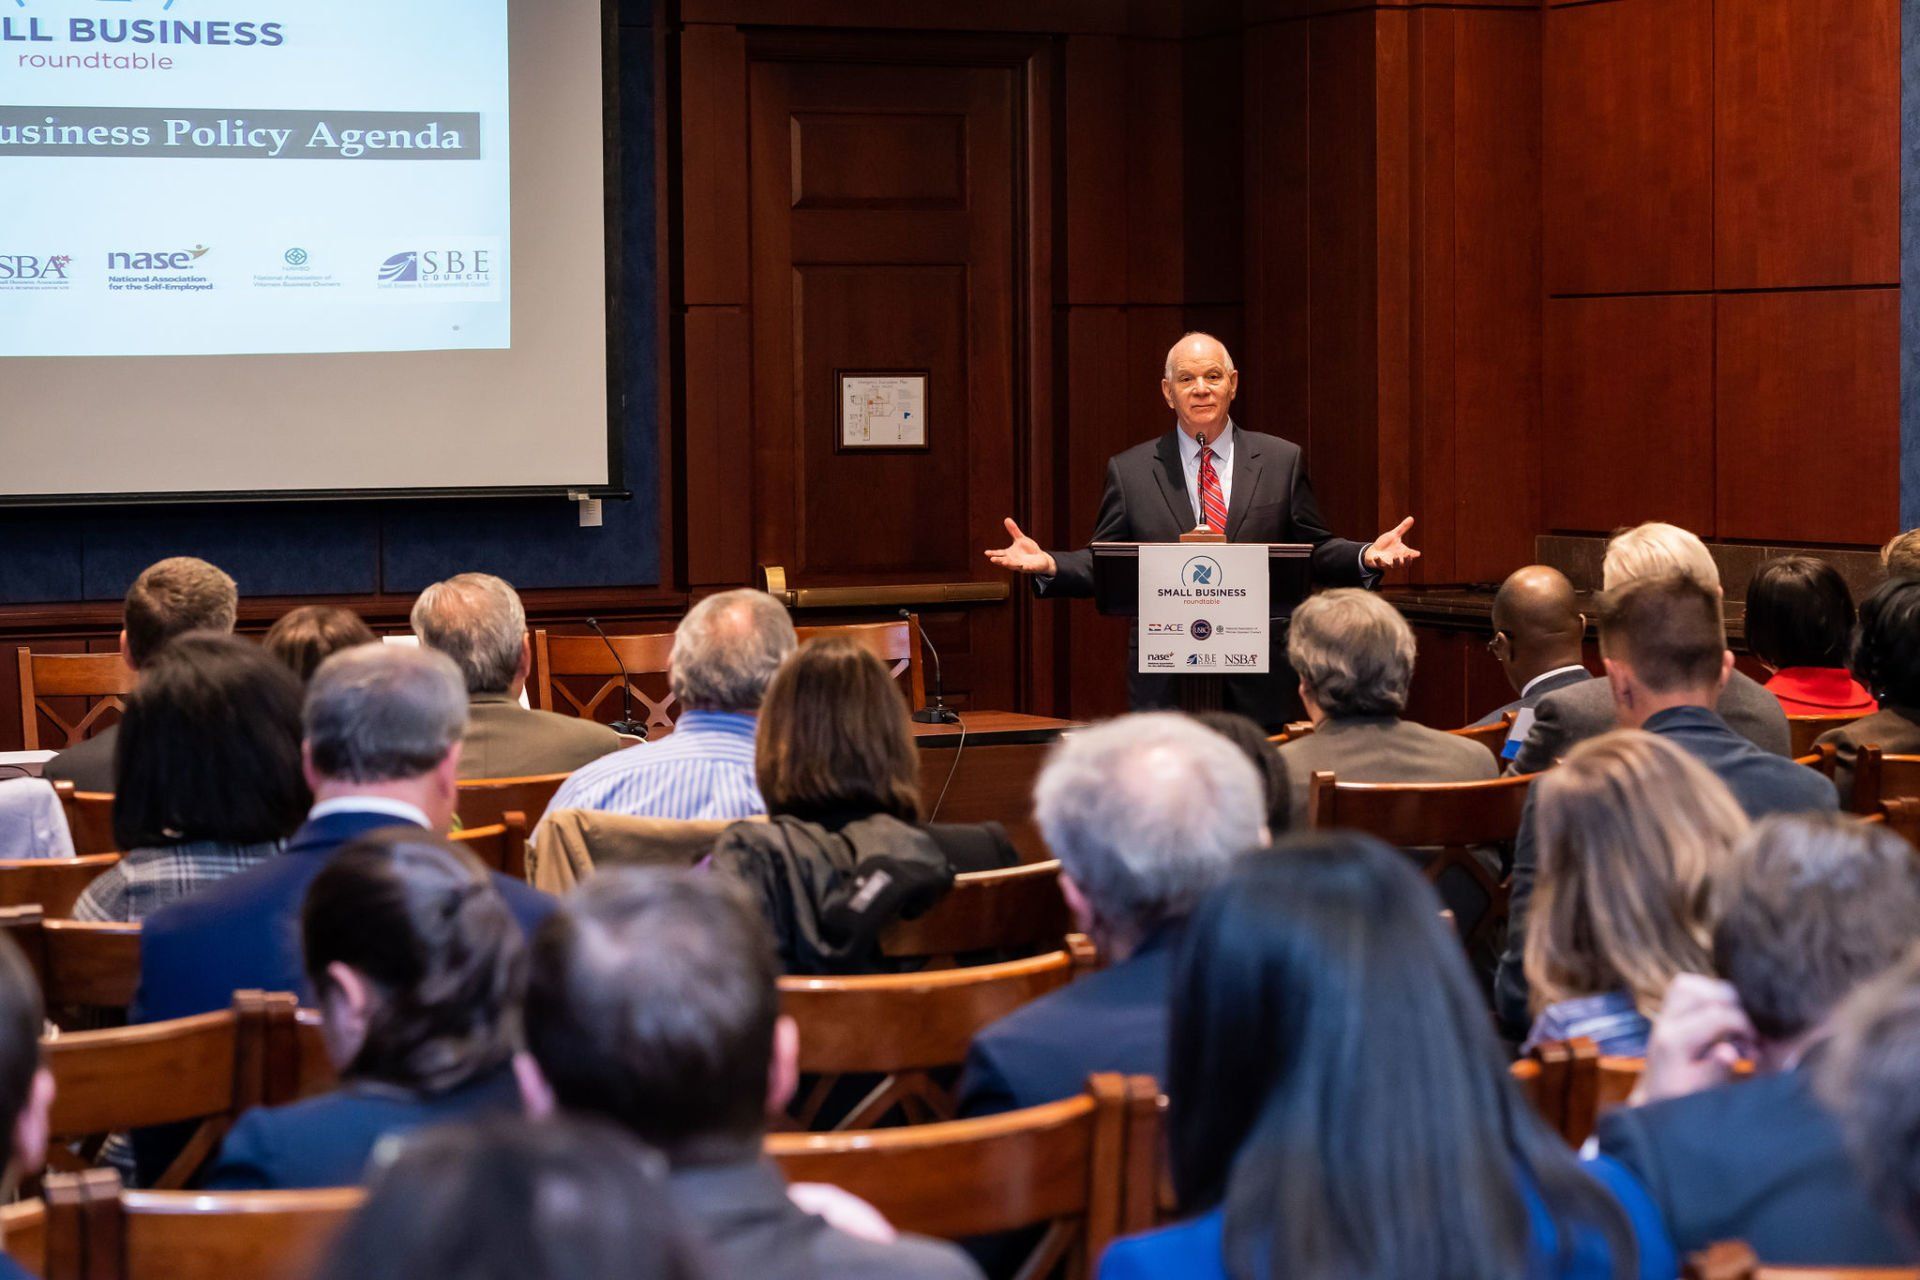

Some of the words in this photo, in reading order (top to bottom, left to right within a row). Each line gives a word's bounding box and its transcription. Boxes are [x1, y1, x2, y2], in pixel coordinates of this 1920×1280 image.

[69, 18, 284, 46] BUSINESS
[19, 51, 173, 70] roundtable
[163, 119, 292, 156] Policy
[305, 121, 462, 157] Agenda
[422, 250, 489, 274] SBE
[1157, 589, 1192, 597] SMALL
[1195, 589, 1246, 597] BUSINESS
[1224, 654, 1257, 664] NSBA
